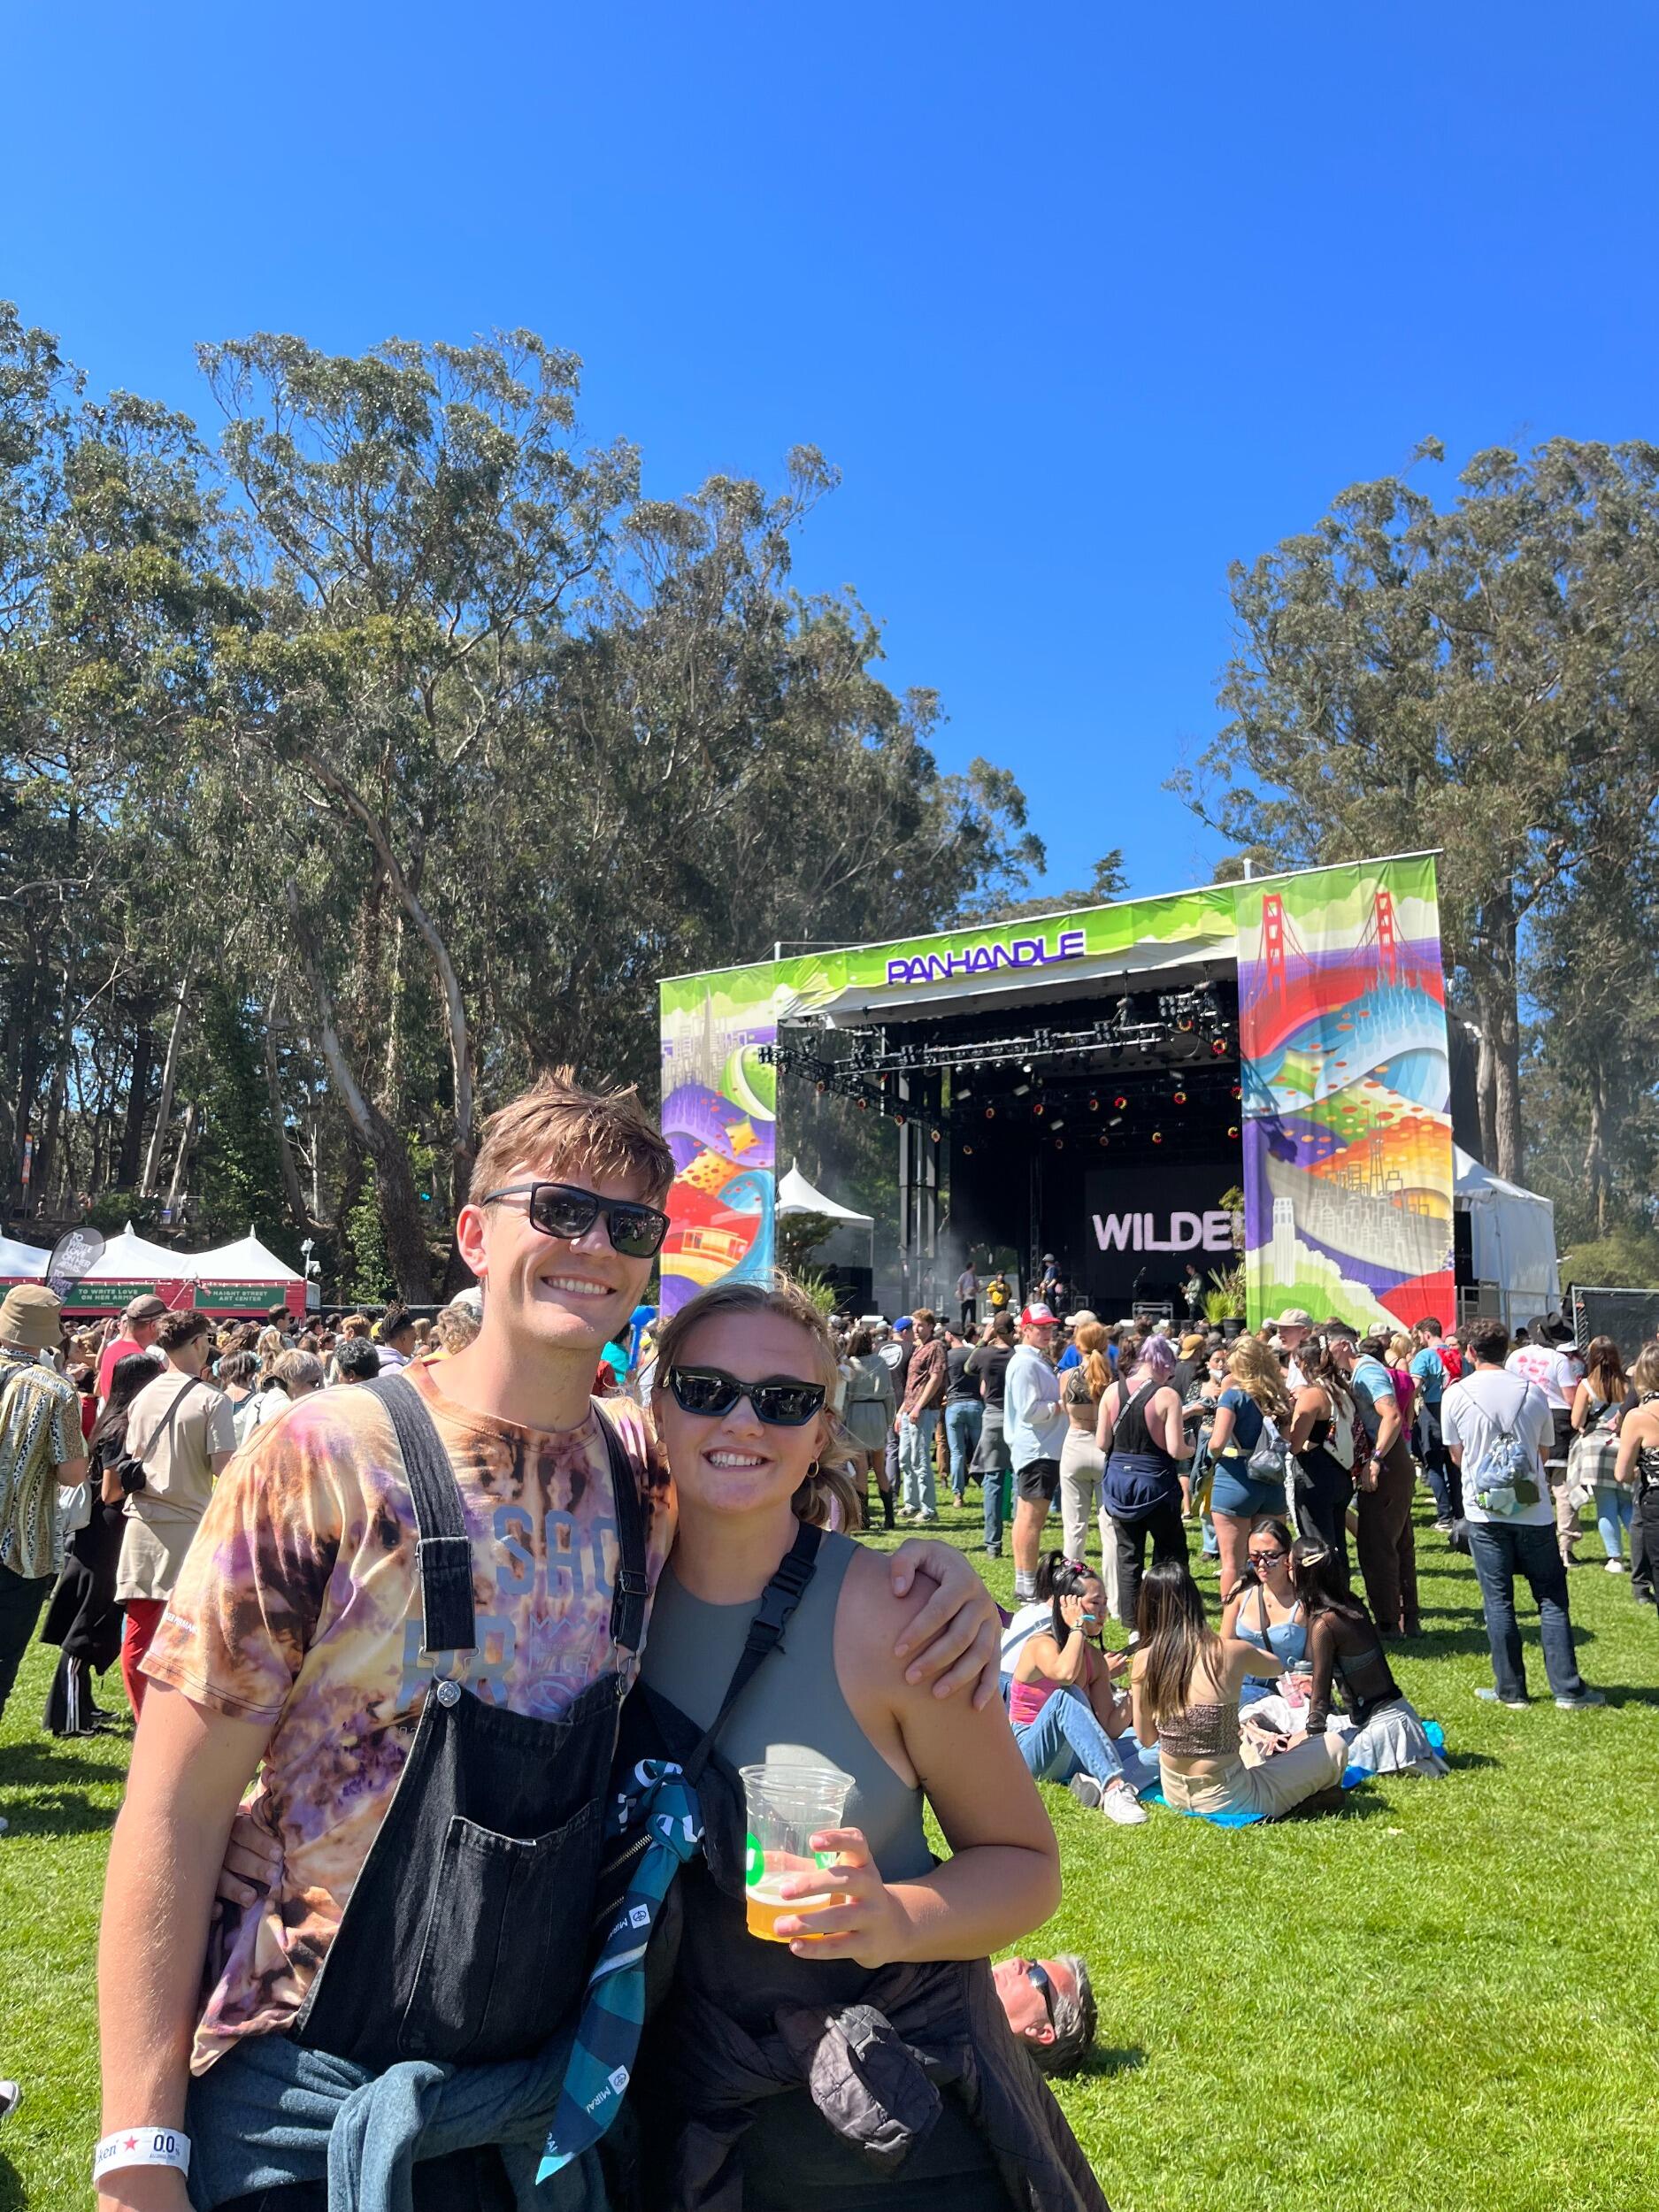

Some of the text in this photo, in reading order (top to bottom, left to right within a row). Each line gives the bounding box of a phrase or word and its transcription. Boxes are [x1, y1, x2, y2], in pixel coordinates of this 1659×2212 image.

[887, 931, 1085, 984] PANHANDLE
[73, 1232, 84, 1241] TO
[65, 1245, 87, 1258] LOVE
[70, 1239, 93, 1253] WRITE
[54, 1269, 65, 1278] TO
[586, 2085, 611, 2115] MIRAI
